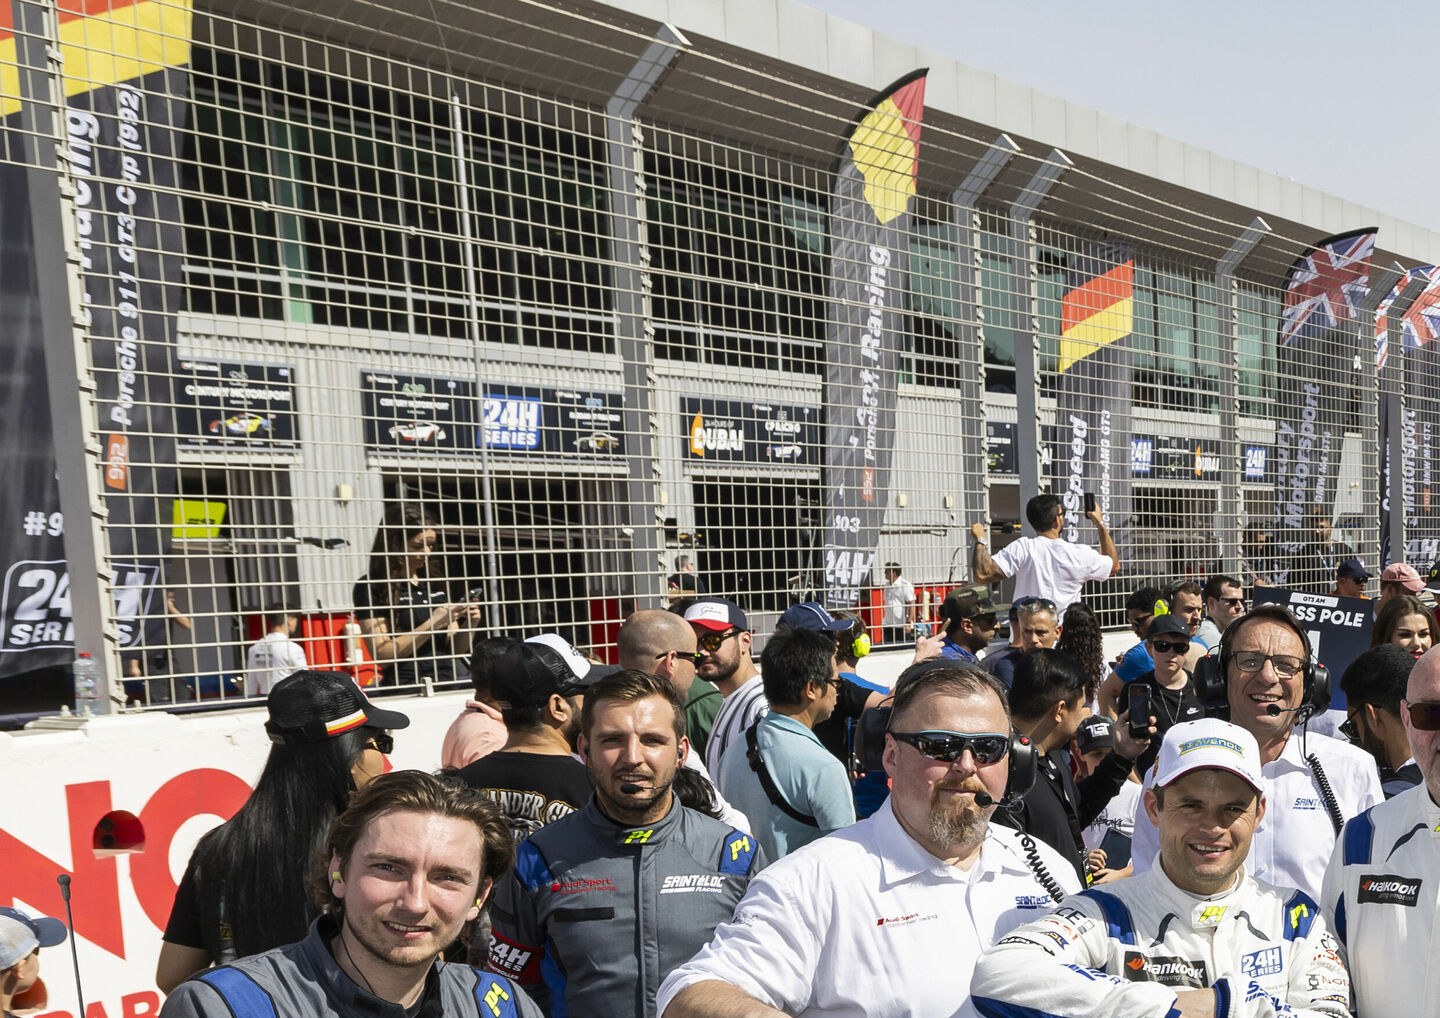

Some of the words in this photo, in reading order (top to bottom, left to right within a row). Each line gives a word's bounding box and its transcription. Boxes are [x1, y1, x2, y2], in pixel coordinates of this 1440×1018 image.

[116, 155, 142, 205] Cup
[117, 214, 136, 263] GT3
[118, 271, 138, 319] 911
[110, 325, 138, 426] Porsche
[484, 400, 539, 431] 24H
[484, 429, 536, 446] SERIES
[694, 427, 744, 451] DUBAI
[24, 511, 64, 536] #9
[1319, 608, 1364, 628] POLE
[10, 621, 133, 645] SERIS
[561, 880, 581, 889] Audi
[584, 877, 611, 889] Sport
[695, 886, 722, 894] RACING
[901, 913, 919, 922] Sport
[1242, 948, 1281, 972] 24H
